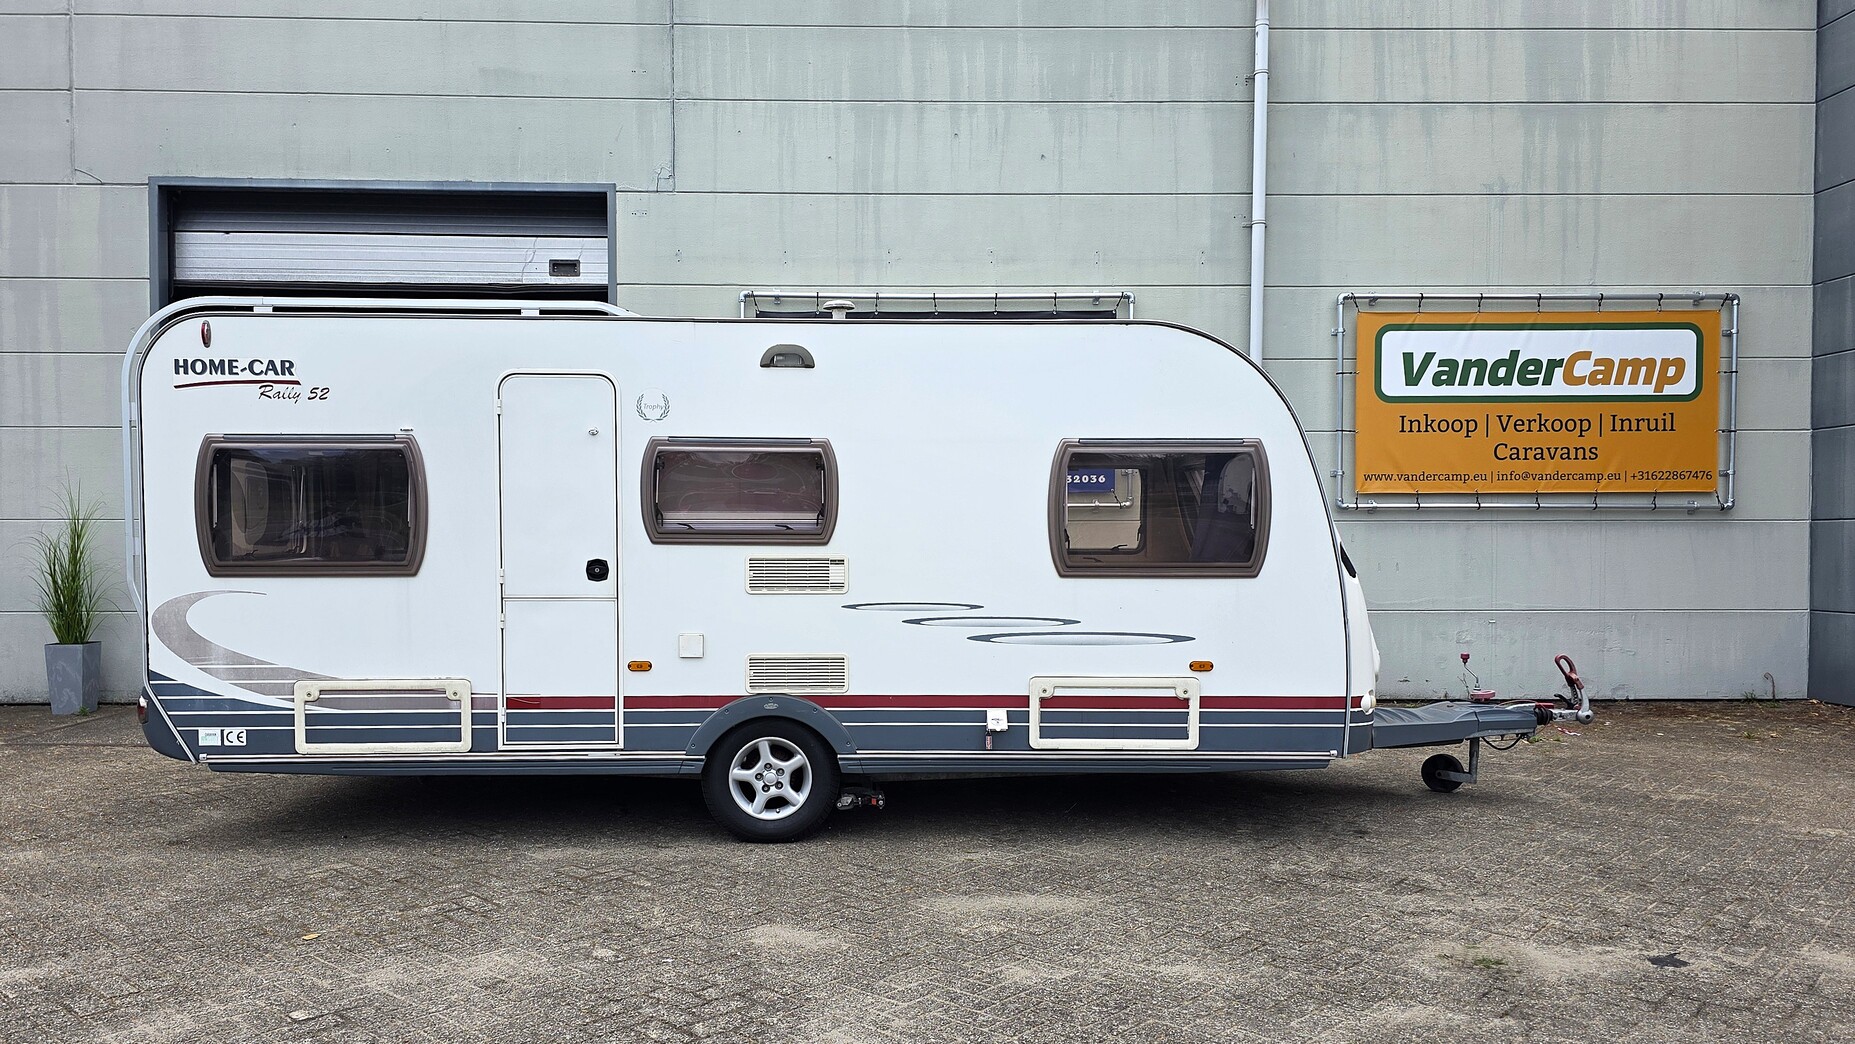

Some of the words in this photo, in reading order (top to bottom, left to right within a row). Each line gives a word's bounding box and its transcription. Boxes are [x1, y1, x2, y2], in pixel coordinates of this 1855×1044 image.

[173, 358, 295, 376] HOME-CAR
[1401, 349, 1687, 394] VanderCamp
[258, 384, 302, 404] Rally
[307, 387, 330, 401] 52
[643, 403, 664, 411] Trophy
[1399, 414, 1478, 438] Inkoop
[1496, 413, 1592, 438] Verkoop
[1610, 412, 1676, 432] Inruil
[1493, 443, 1599, 461] Caravans
[1363, 471, 1488, 484] www.vandercamp.eu
[1496, 470, 1622, 483] info@vandercamp.eu
[1630, 470, 1713, 481] +31622867476
[226, 731, 244, 743] CE
